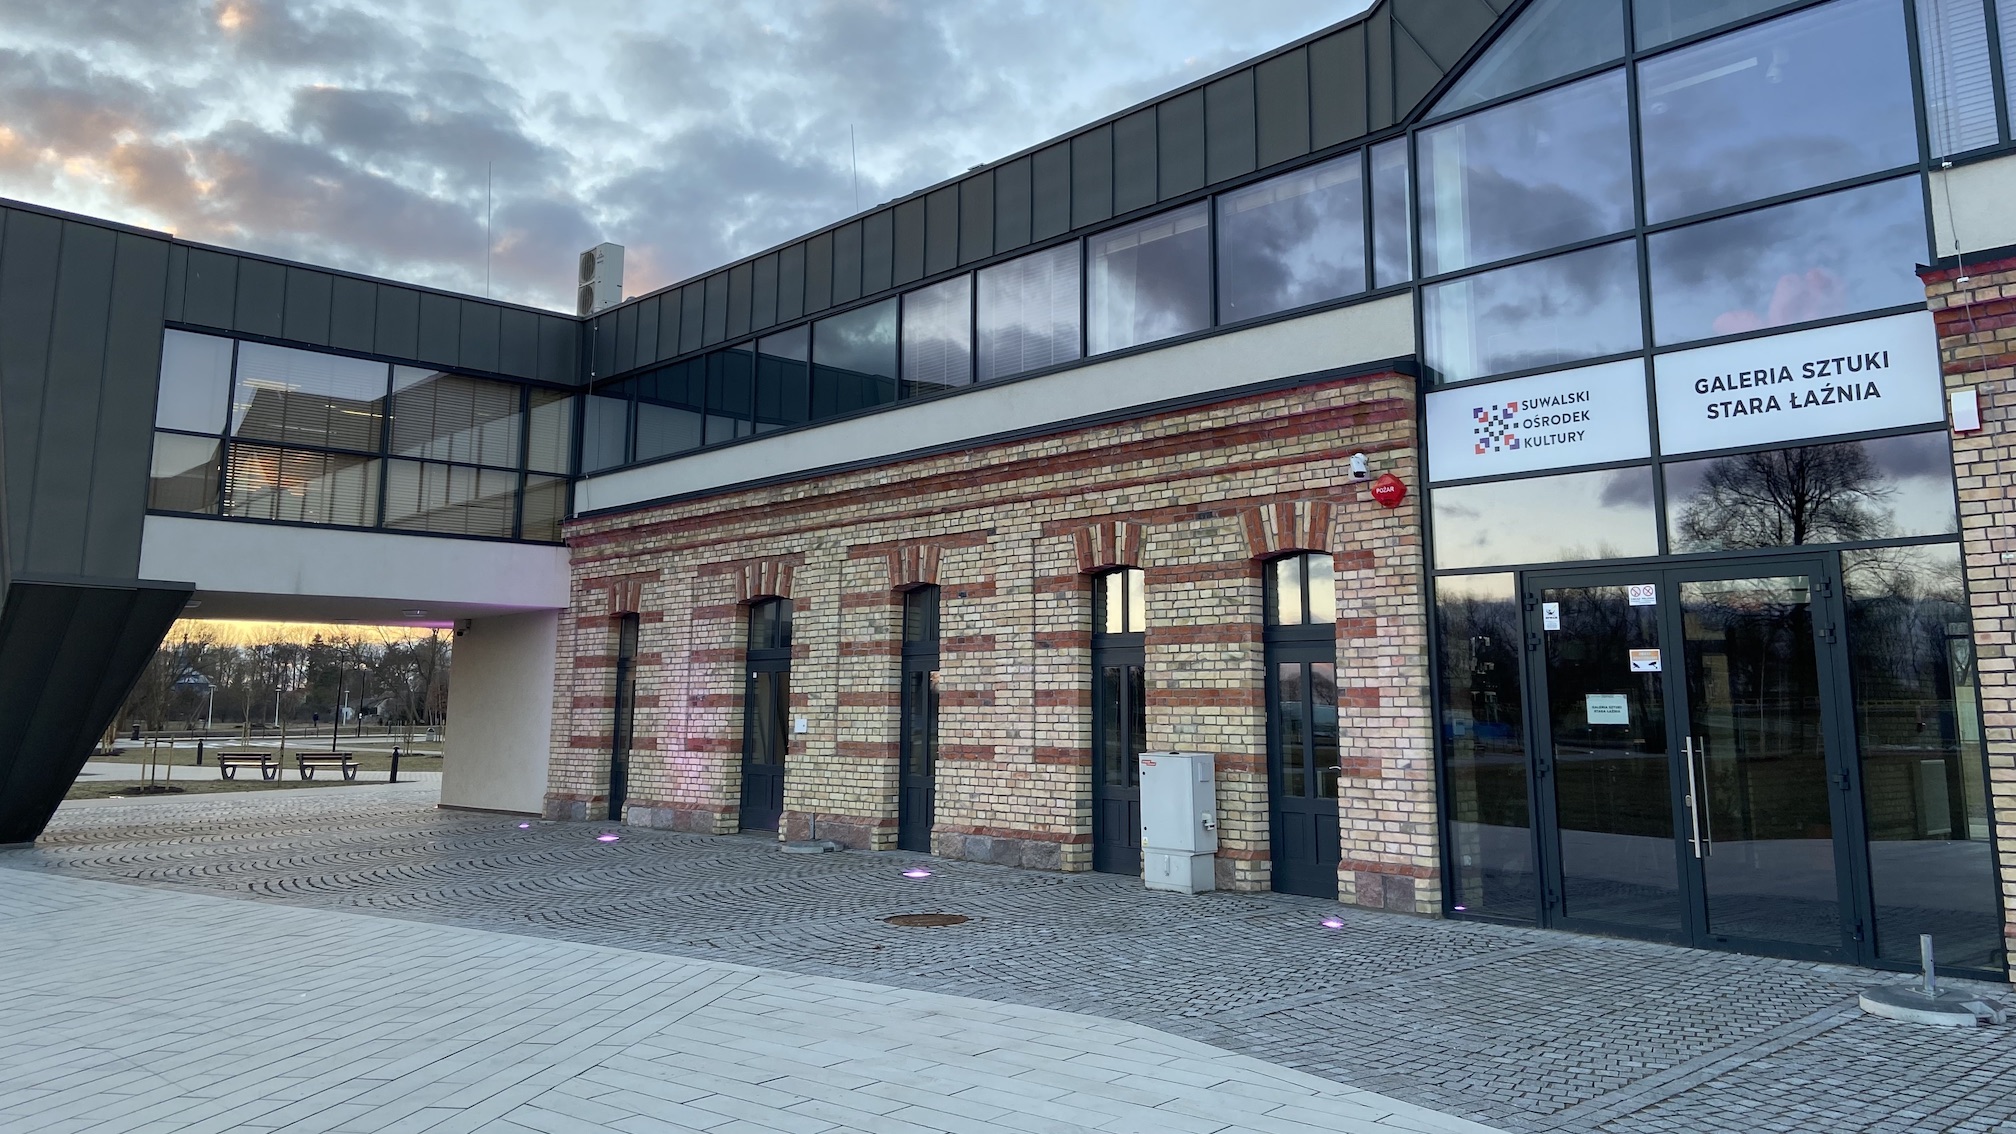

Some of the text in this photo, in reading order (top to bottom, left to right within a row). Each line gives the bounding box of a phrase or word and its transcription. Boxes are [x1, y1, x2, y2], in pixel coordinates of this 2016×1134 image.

[1694, 350, 1889, 395] GALERIA SZTUKI
[1521, 390, 1590, 411] SUWALSKI
[1707, 381, 1882, 420] STARA ŁAŹNIA
[1522, 409, 1591, 429] OŚRODEK
[1524, 430, 1585, 449] KULTURY
[1376, 486, 1394, 494] POŻAR
